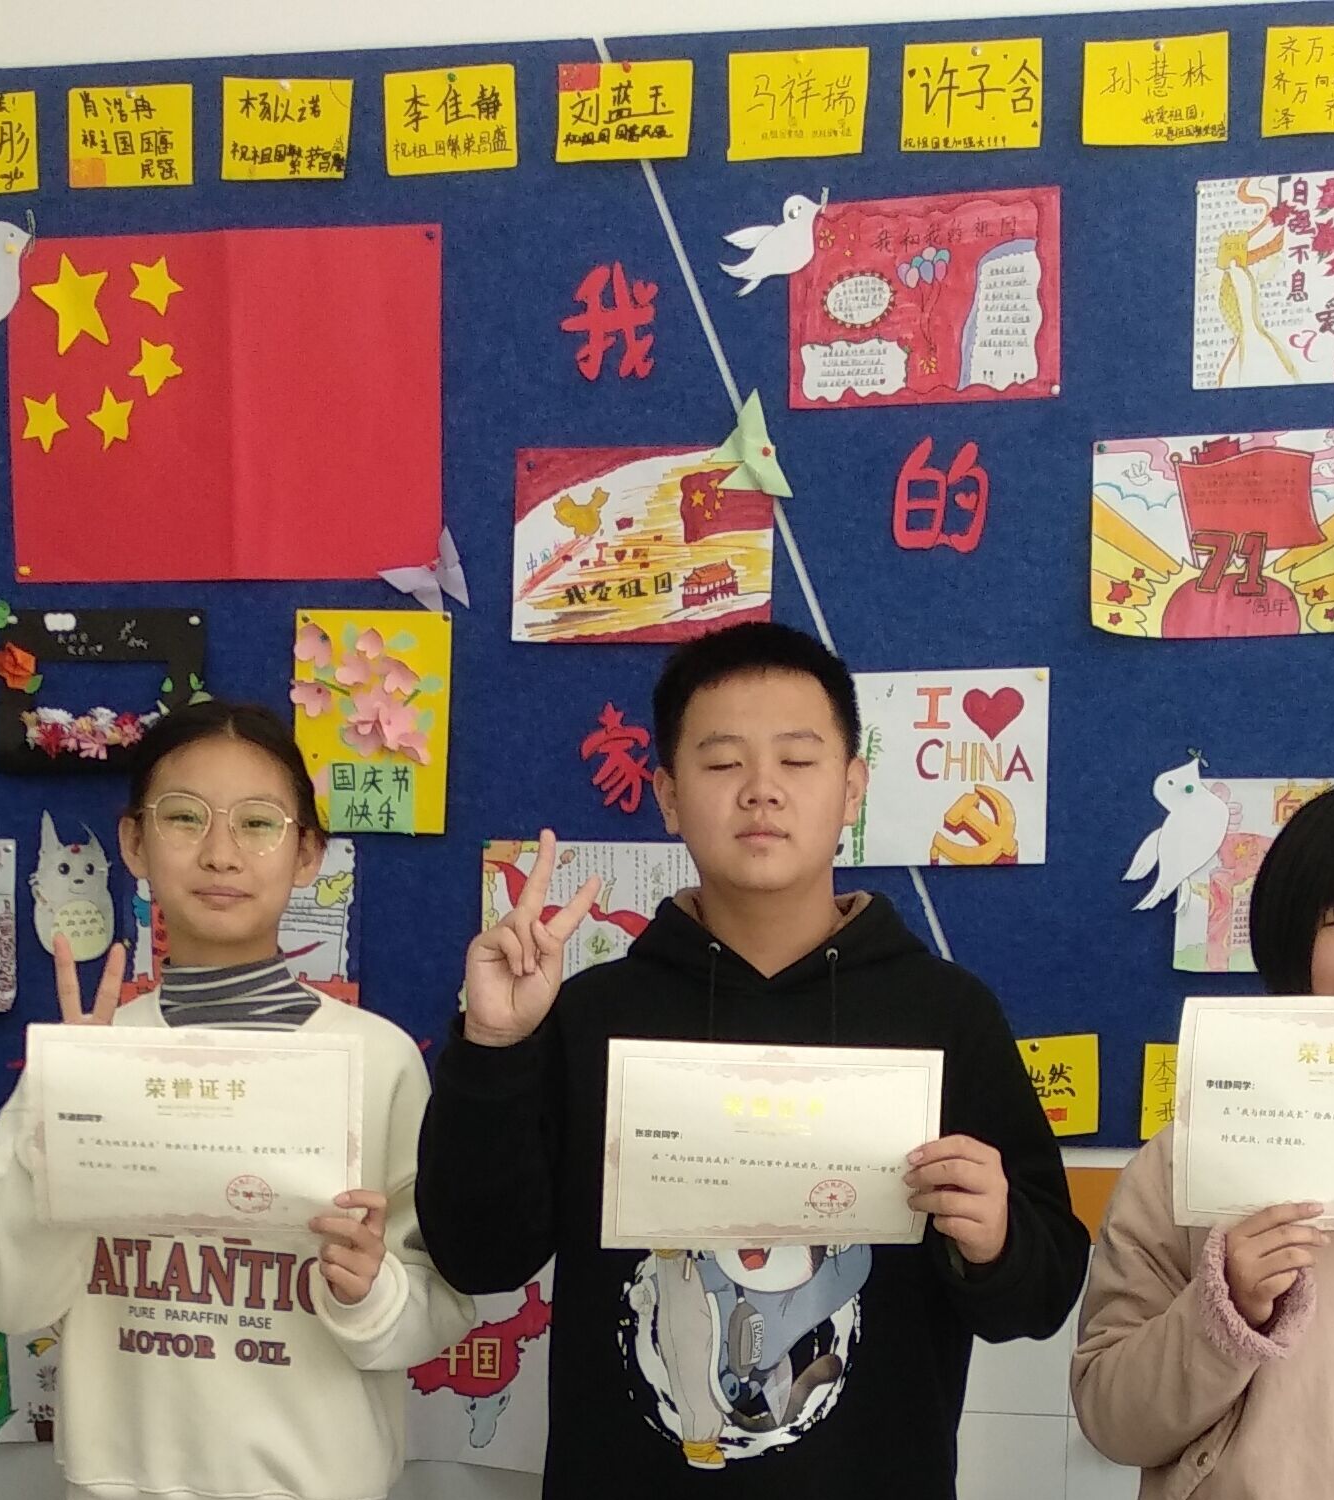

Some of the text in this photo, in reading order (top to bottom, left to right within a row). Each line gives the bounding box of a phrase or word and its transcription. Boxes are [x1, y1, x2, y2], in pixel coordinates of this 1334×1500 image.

[919, 57, 1040, 128] 许子含
[1099, 50, 1214, 98] 孙慧林
[238, 89, 323, 124] 杨以诺
[402, 84, 503, 133] 李佳静
[570, 80, 675, 127] 刘蓝玉
[746, 74, 857, 124] 马祥瑞
[559, 261, 660, 382] 我
[893, 436, 991, 553] 的
[1192, 530, 1267, 597] 71
[913, 687, 951, 730] I
[331, 763, 412, 794] 国庆节
[579, 701, 655, 814] 家
[915, 737, 1034, 783] CHINA
[343, 796, 398, 831] 快乐
[145, 1077, 247, 1100] 荣誉证书
[128, 1305, 273, 1330] PURE PARAFFIN BASE
[119, 1326, 291, 1366] MOTOR OIL
[443, 1337, 502, 1379] 中国
